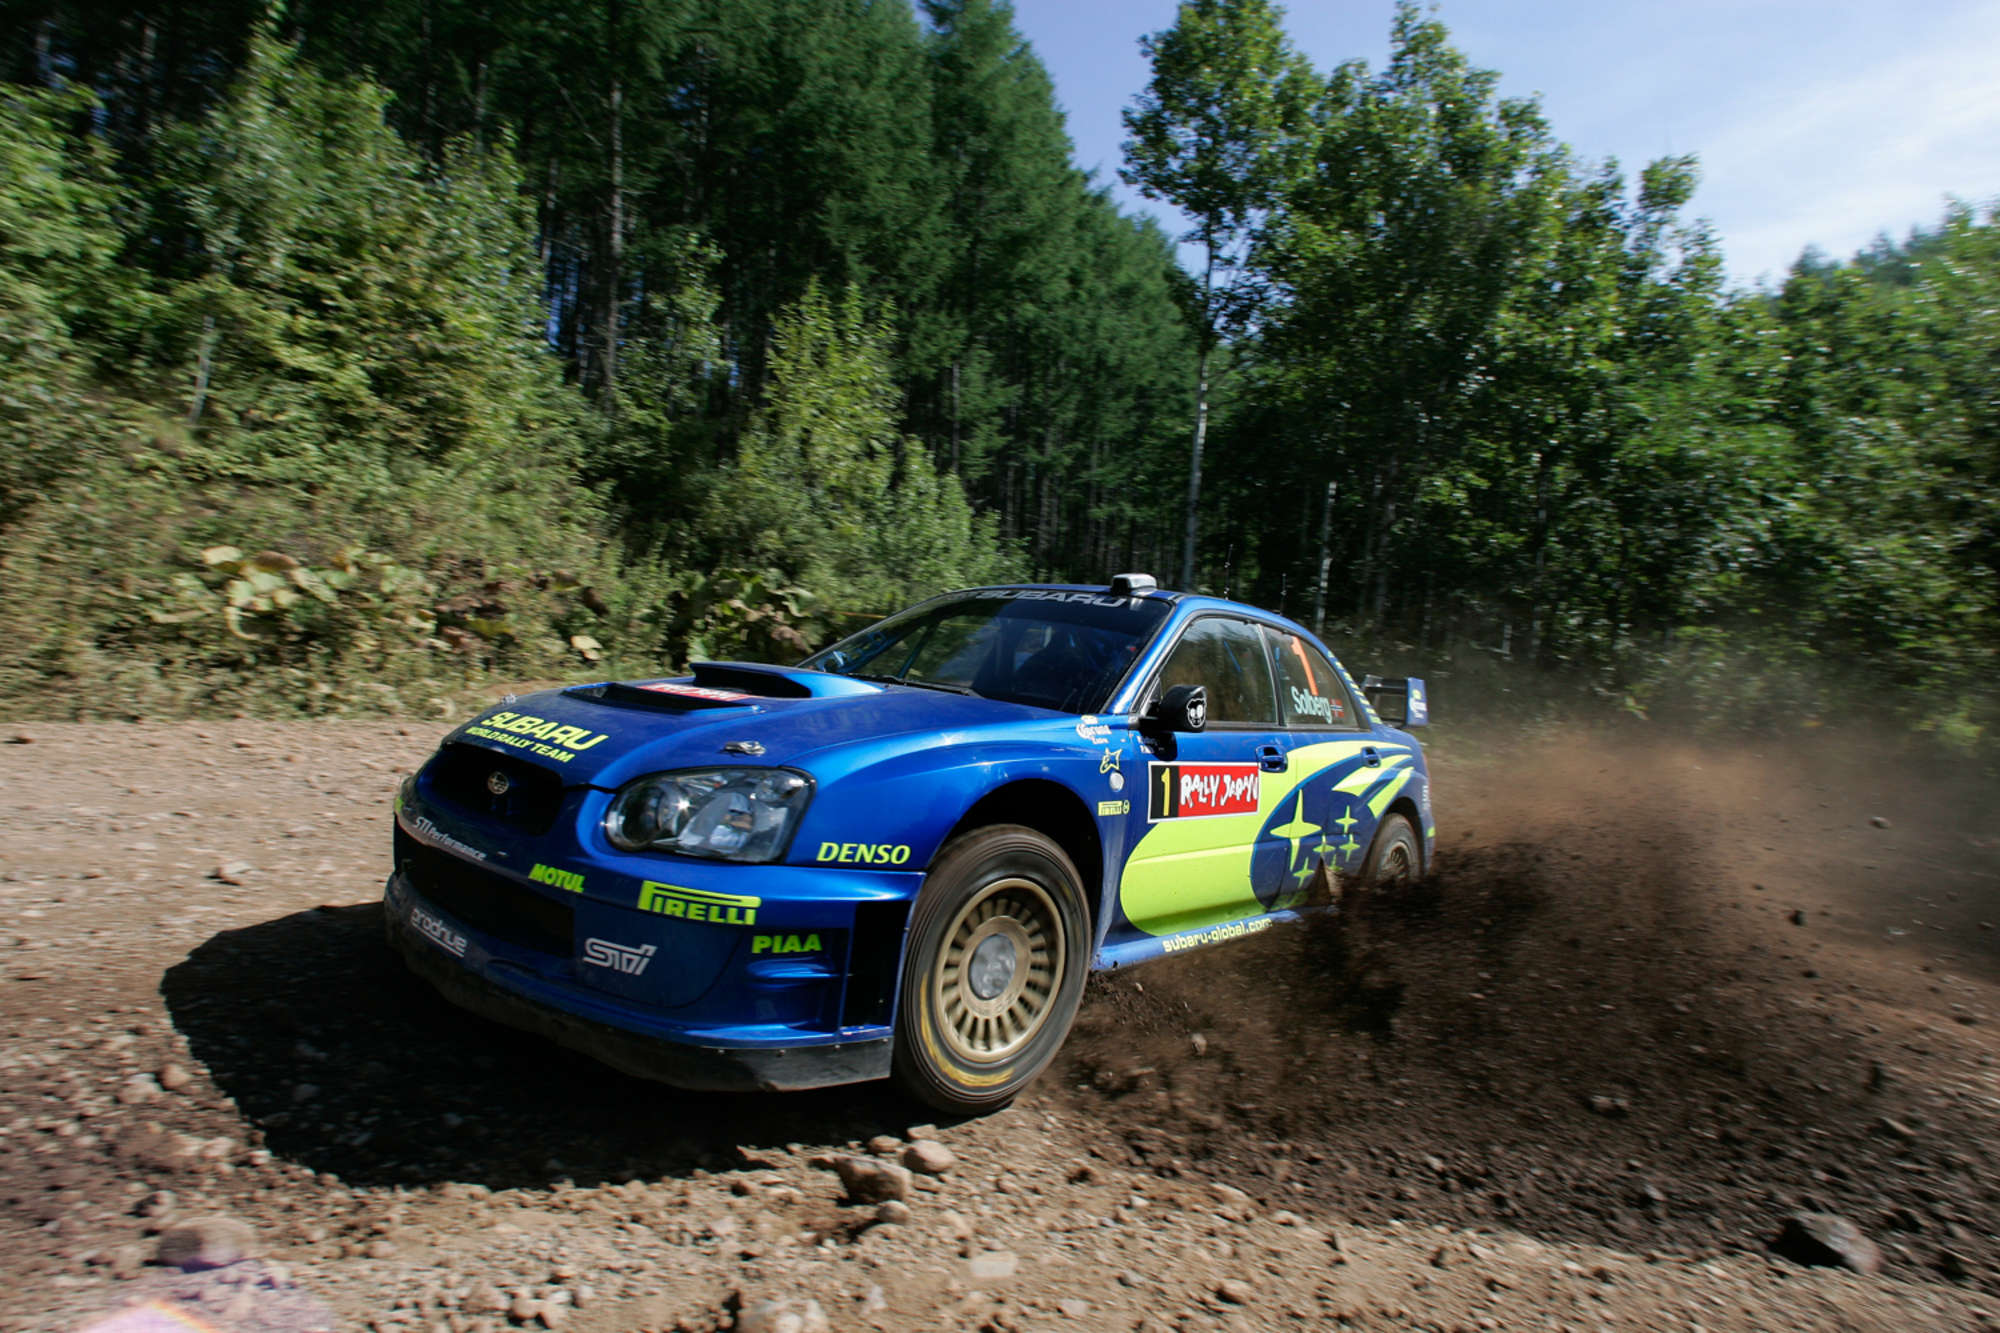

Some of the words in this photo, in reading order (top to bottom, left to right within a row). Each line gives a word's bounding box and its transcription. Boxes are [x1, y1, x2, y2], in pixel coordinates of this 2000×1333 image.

[976, 590, 1127, 607] SUBARU
[1291, 635, 1319, 696] 1
[1291, 685, 1333, 724] Solberg
[465, 726, 499, 741] WORLD
[495, 733, 535, 749] RALLY
[529, 742, 576, 763] TEAM
[480, 711, 609, 751] SUBARU
[1160, 767, 1171, 816] 1
[413, 816, 433, 834] STI
[816, 841, 912, 865] DENSO
[528, 863, 586, 893] MOTUL
[637, 880, 762, 926] PIRELLI
[751, 933, 823, 954] PIAA
